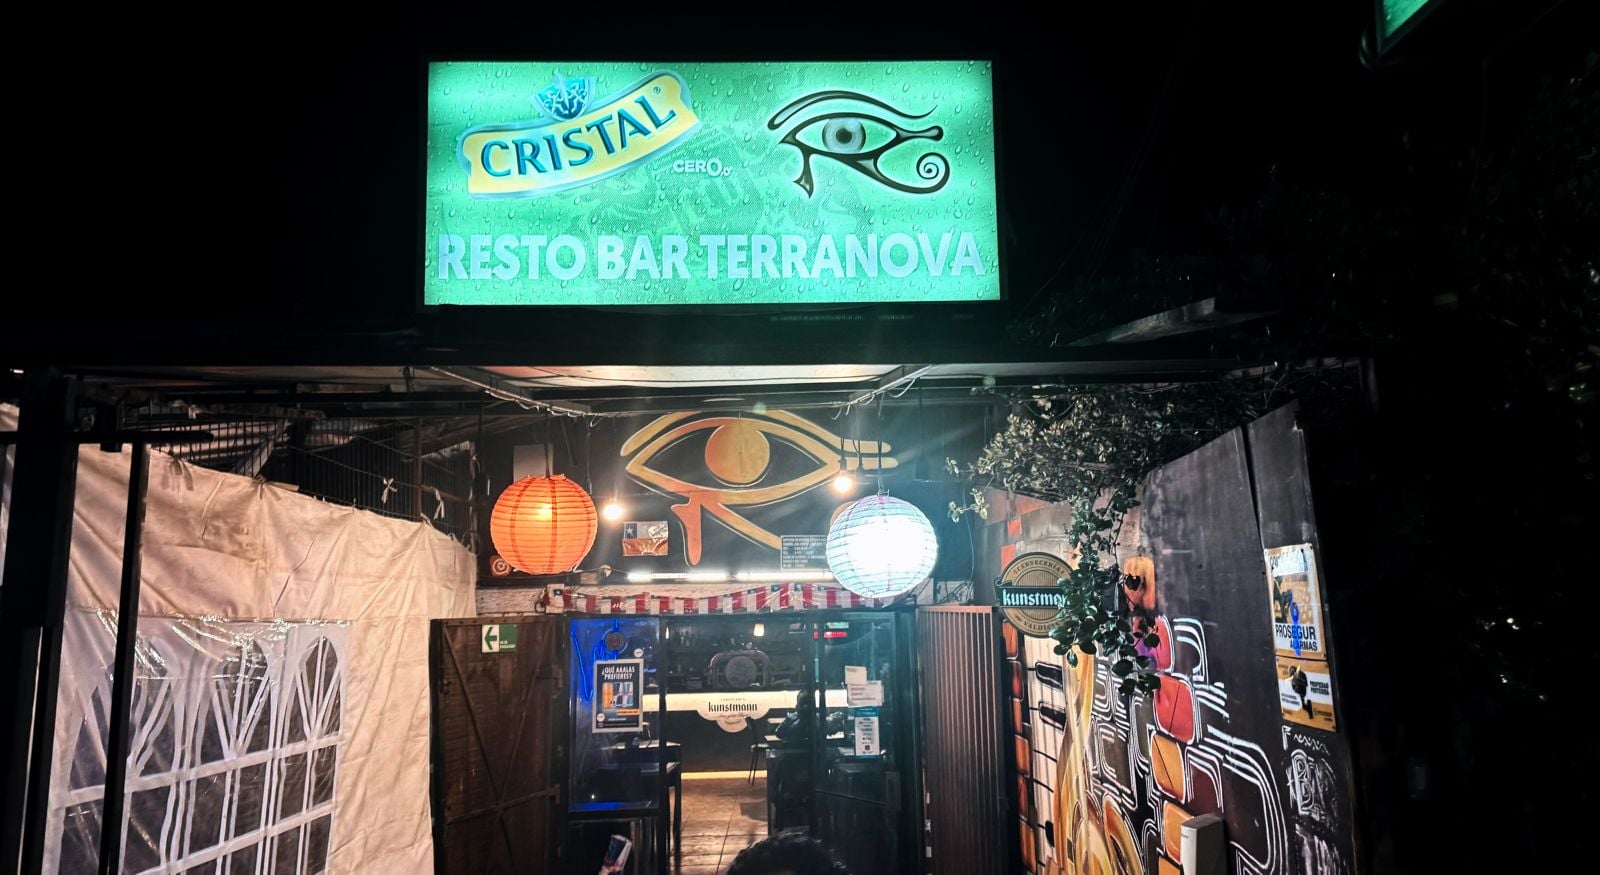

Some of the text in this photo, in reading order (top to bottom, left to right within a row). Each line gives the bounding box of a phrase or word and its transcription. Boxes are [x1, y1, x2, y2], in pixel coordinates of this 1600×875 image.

[480, 94, 677, 178] CRISTAL
[438, 231, 986, 281] RESTO BAR TERRANOVA
[1002, 589, 1070, 606] kunstma
[1275, 624, 1316, 640] PROSEGUR
[1290, 640, 1318, 651] ALARMAS
[708, 702, 758, 712] kunstmann
